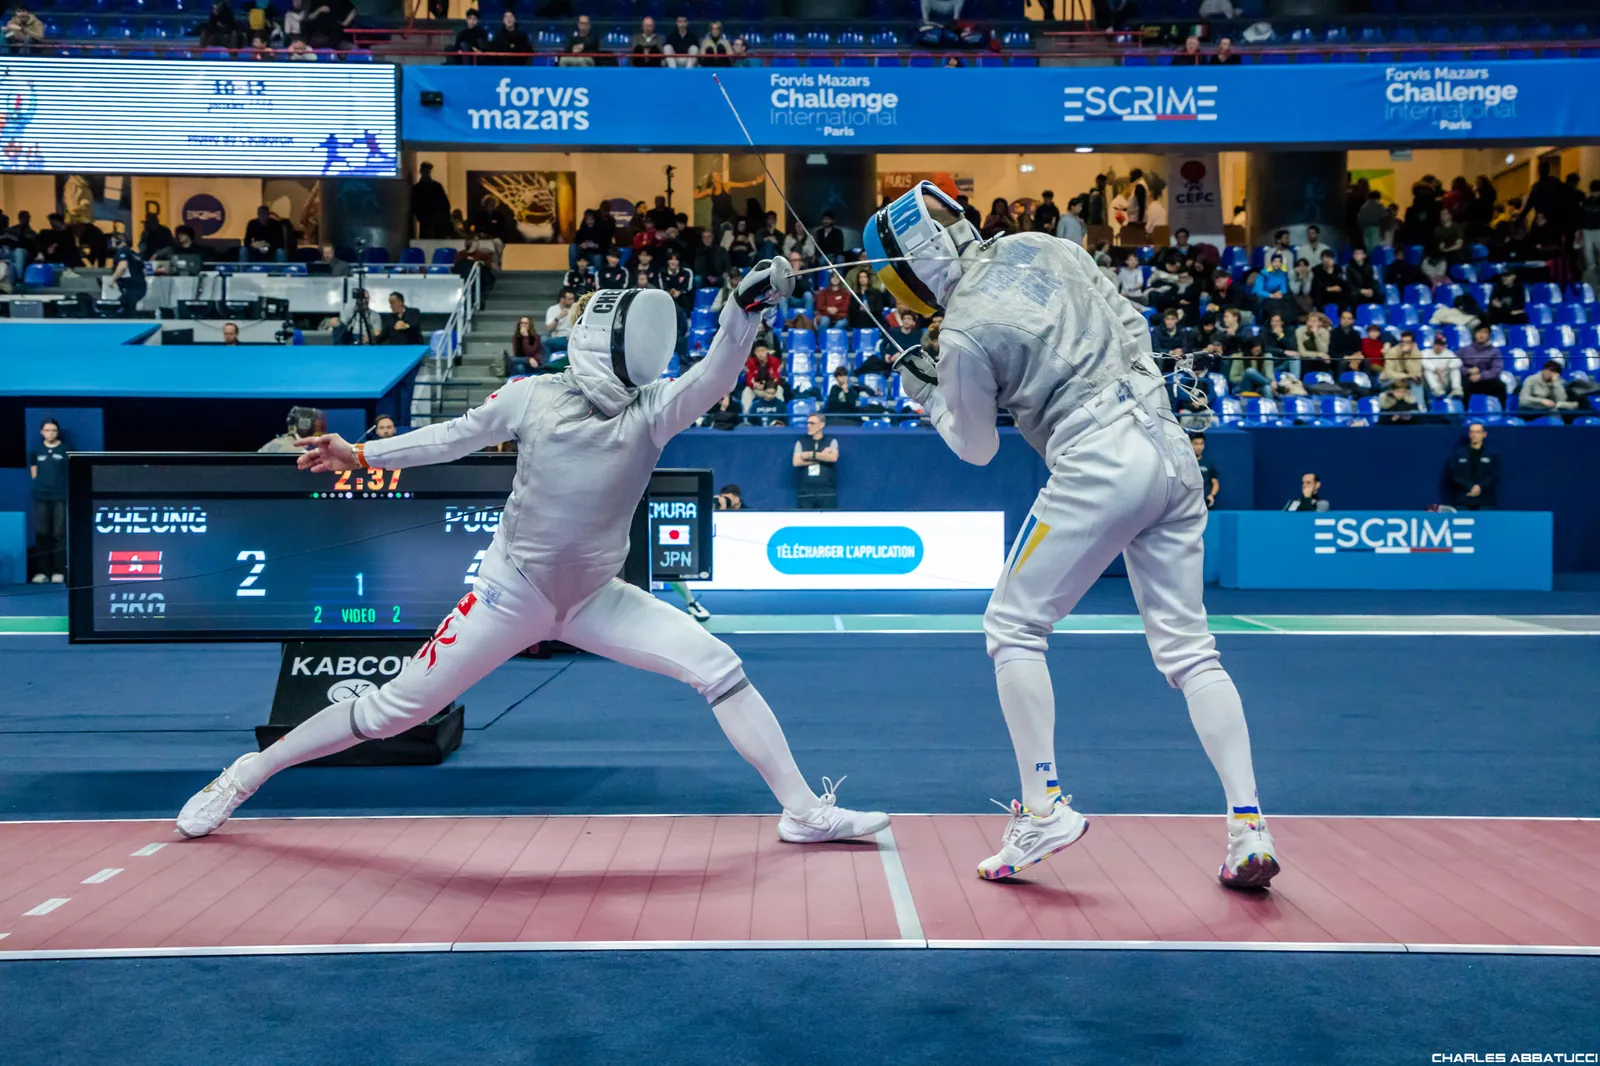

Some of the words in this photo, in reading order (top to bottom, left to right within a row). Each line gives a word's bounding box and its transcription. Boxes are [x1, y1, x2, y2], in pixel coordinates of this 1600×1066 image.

[771, 73, 815, 87] Forvis
[818, 73, 870, 87] Mazars
[1385, 67, 1431, 81] Forvis
[1434, 66, 1489, 80] Mazars
[495, 77, 589, 107] forvis
[771, 88, 899, 113] Challenge
[1064, 85, 1218, 122] ESCRIME
[1386, 81, 1518, 106] Challenge
[467, 108, 590, 131] mazars
[770, 107, 898, 126] International
[1384, 102, 1516, 120] International
[823, 125, 855, 137] Paris
[889, 189, 922, 237] UKR
[334, 467, 402, 490] 2:37
[95, 506, 207, 533] CHEUNG
[445, 506, 504, 532] POG
[1314, 517, 1474, 554] ESCRIME
[660, 551, 692, 567] JPN
[776, 543, 844, 559] TÉLÉCHARGER
[846, 545, 915, 559] L'APPLICATION
[236, 551, 266, 597] 2
[354, 572, 364, 596] 1
[313, 606, 322, 623] 2
[342, 608, 376, 623] VIDEO
[392, 606, 401, 623] 2
